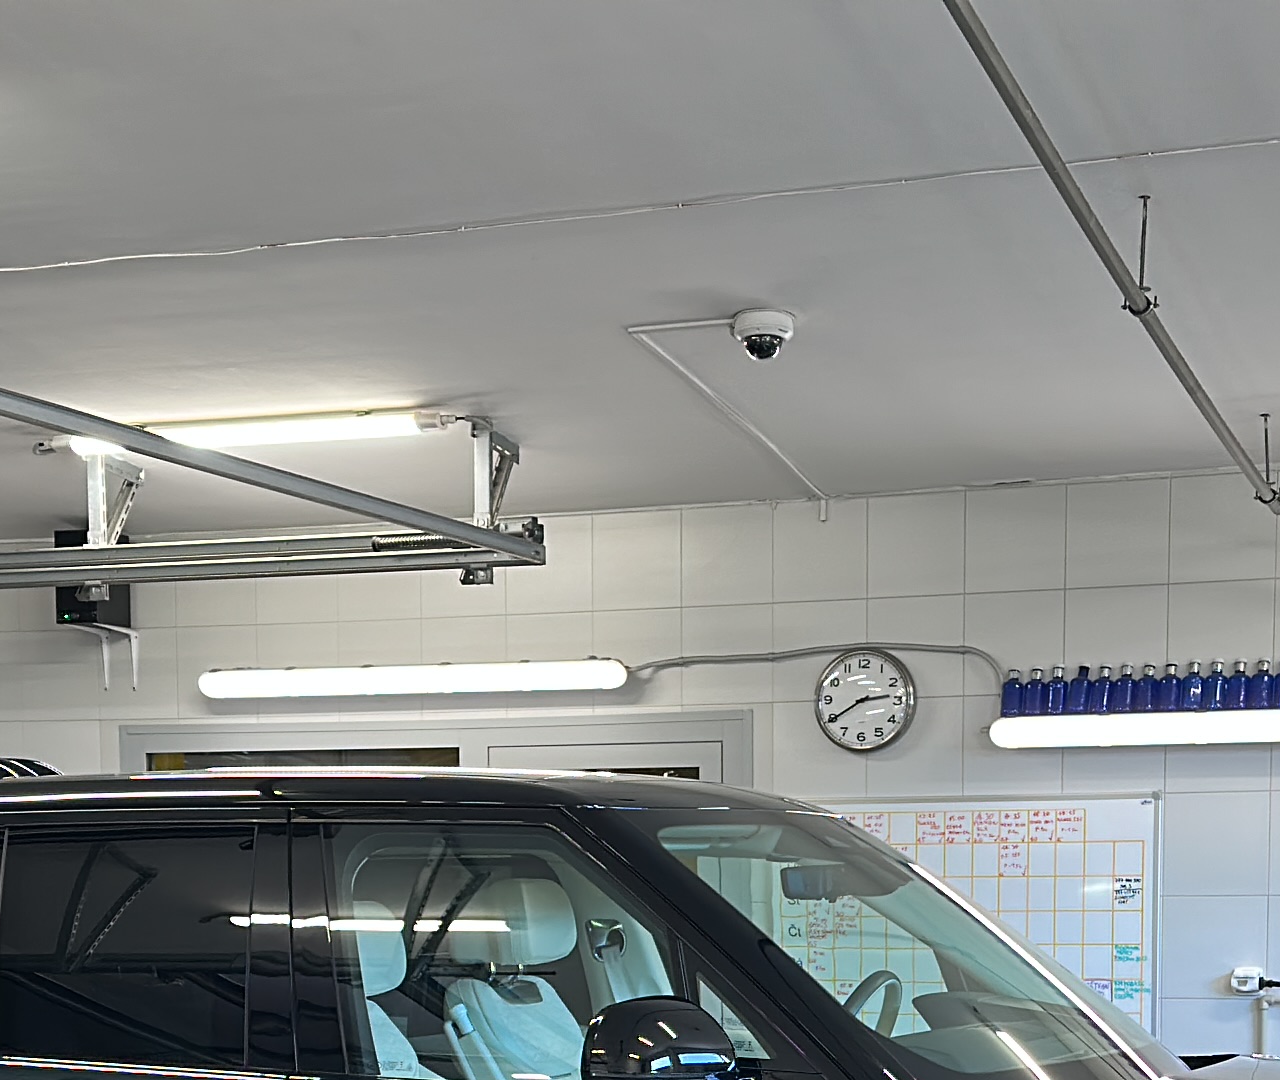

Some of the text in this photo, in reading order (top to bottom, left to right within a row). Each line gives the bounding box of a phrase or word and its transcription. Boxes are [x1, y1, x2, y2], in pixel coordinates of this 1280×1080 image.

[844, 664, 851, 673] 11
[858, 659, 870, 669] 12
[880, 664, 884, 673] 1
[830, 678, 840, 687] 10
[889, 678, 898, 687] 2
[824, 695, 833, 704] 9
[893, 696, 903, 705] 3
[887, 714, 896, 724] 4
[840, 727, 849, 737] 7
[874, 727, 884, 737] 5
[856, 732, 866, 742] 6
